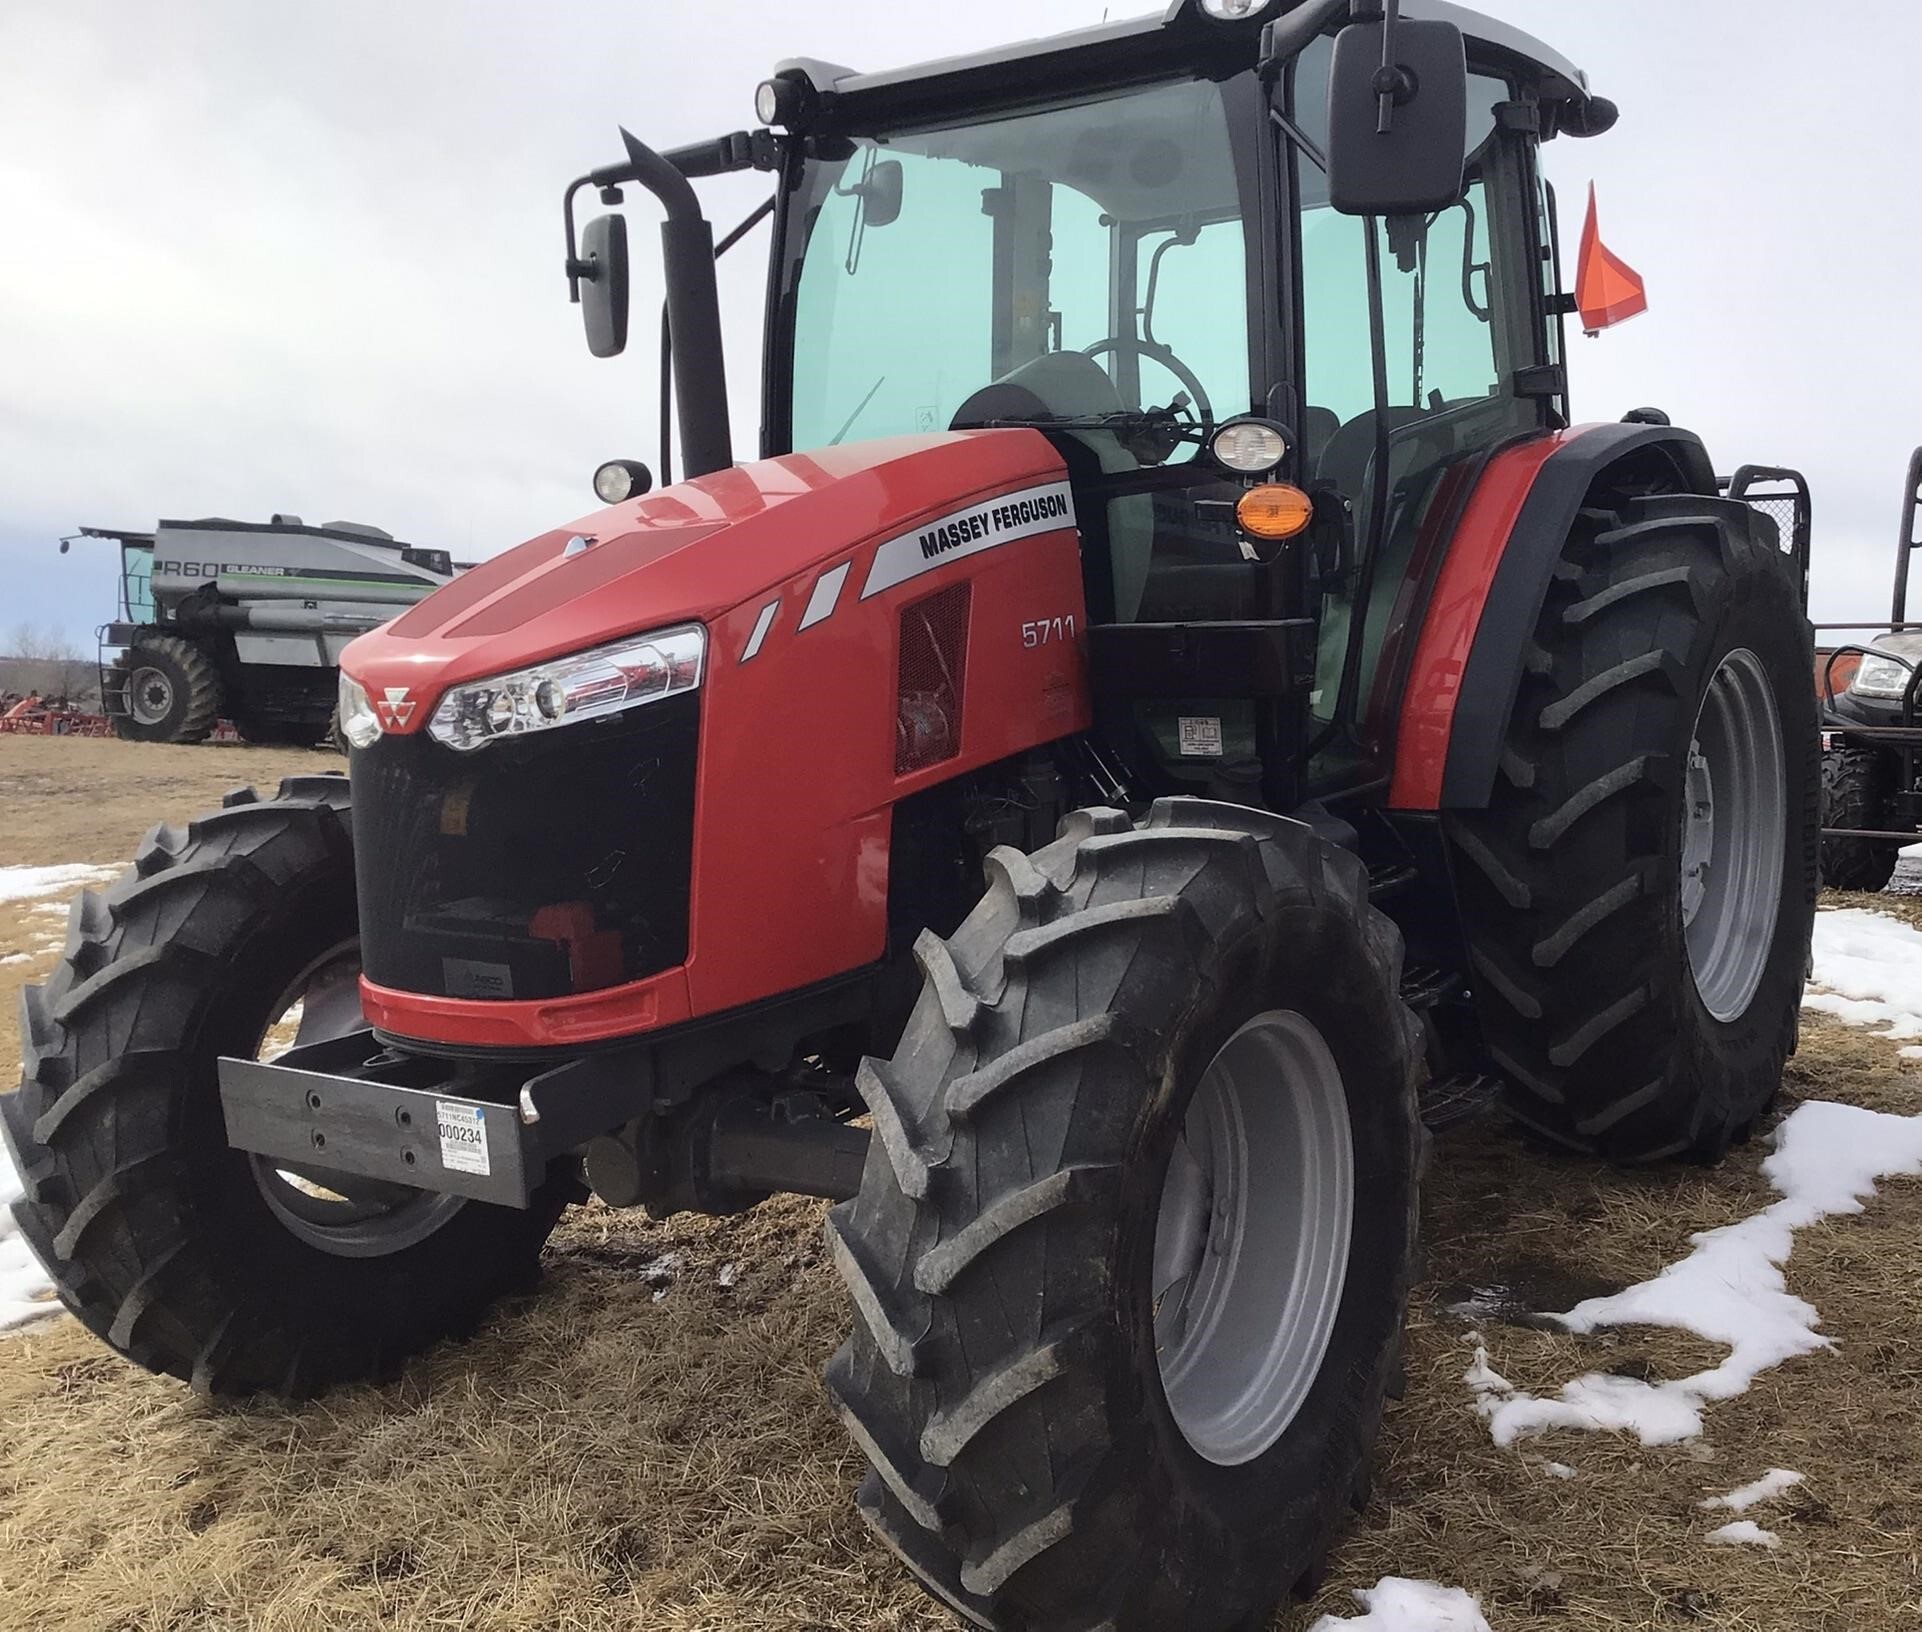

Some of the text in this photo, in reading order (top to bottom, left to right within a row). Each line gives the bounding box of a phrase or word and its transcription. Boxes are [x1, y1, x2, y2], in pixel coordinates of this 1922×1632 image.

[919, 494, 1068, 559] MASSEY FERGUSON
[164, 561, 219, 578] R60
[226, 565, 285, 576] GLEANER
[1022, 615, 1075, 648] 5711
[438, 1123, 482, 1144] 000234
